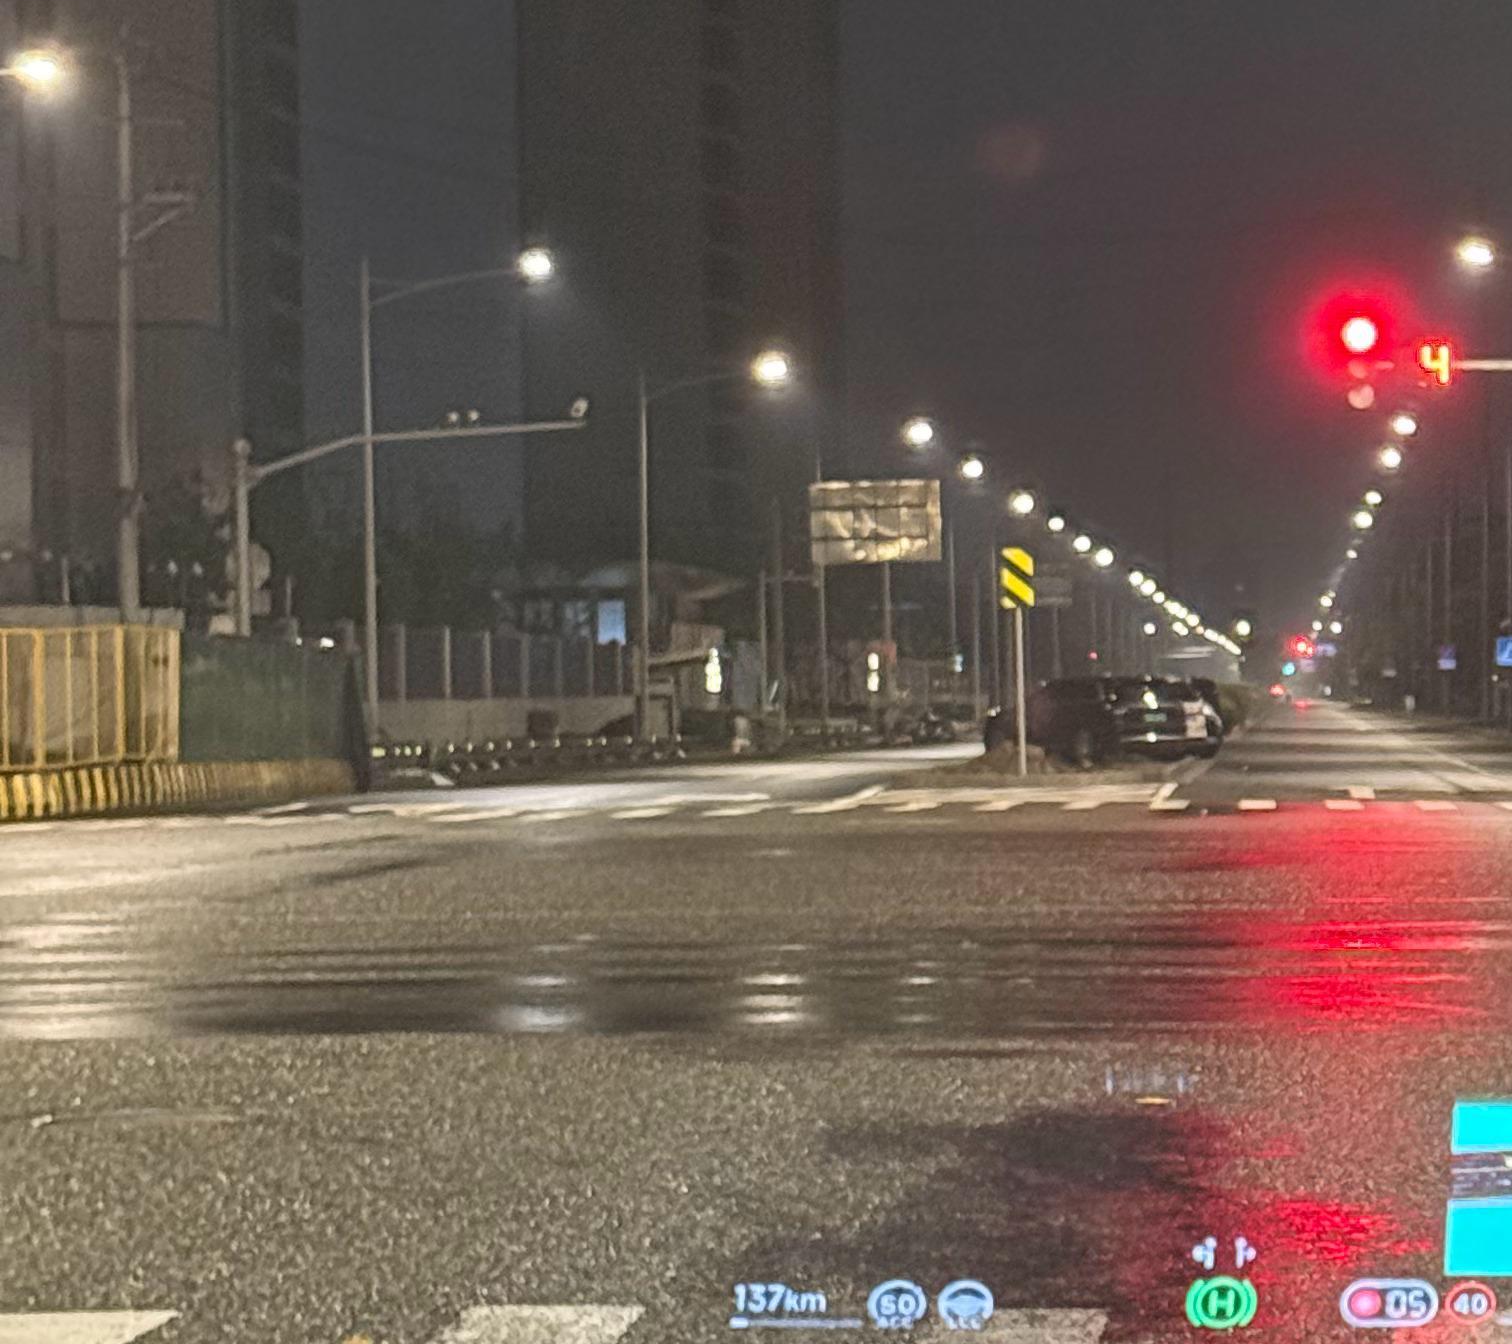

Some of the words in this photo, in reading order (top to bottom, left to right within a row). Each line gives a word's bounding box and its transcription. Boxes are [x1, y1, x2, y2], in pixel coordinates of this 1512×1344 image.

[1419, 344, 1450, 384] 4
[733, 1283, 827, 1312] 137km
[1208, 1289, 1236, 1318] H
[1385, 1289, 1427, 1319] 05
[1453, 1292, 1488, 1316] 40
